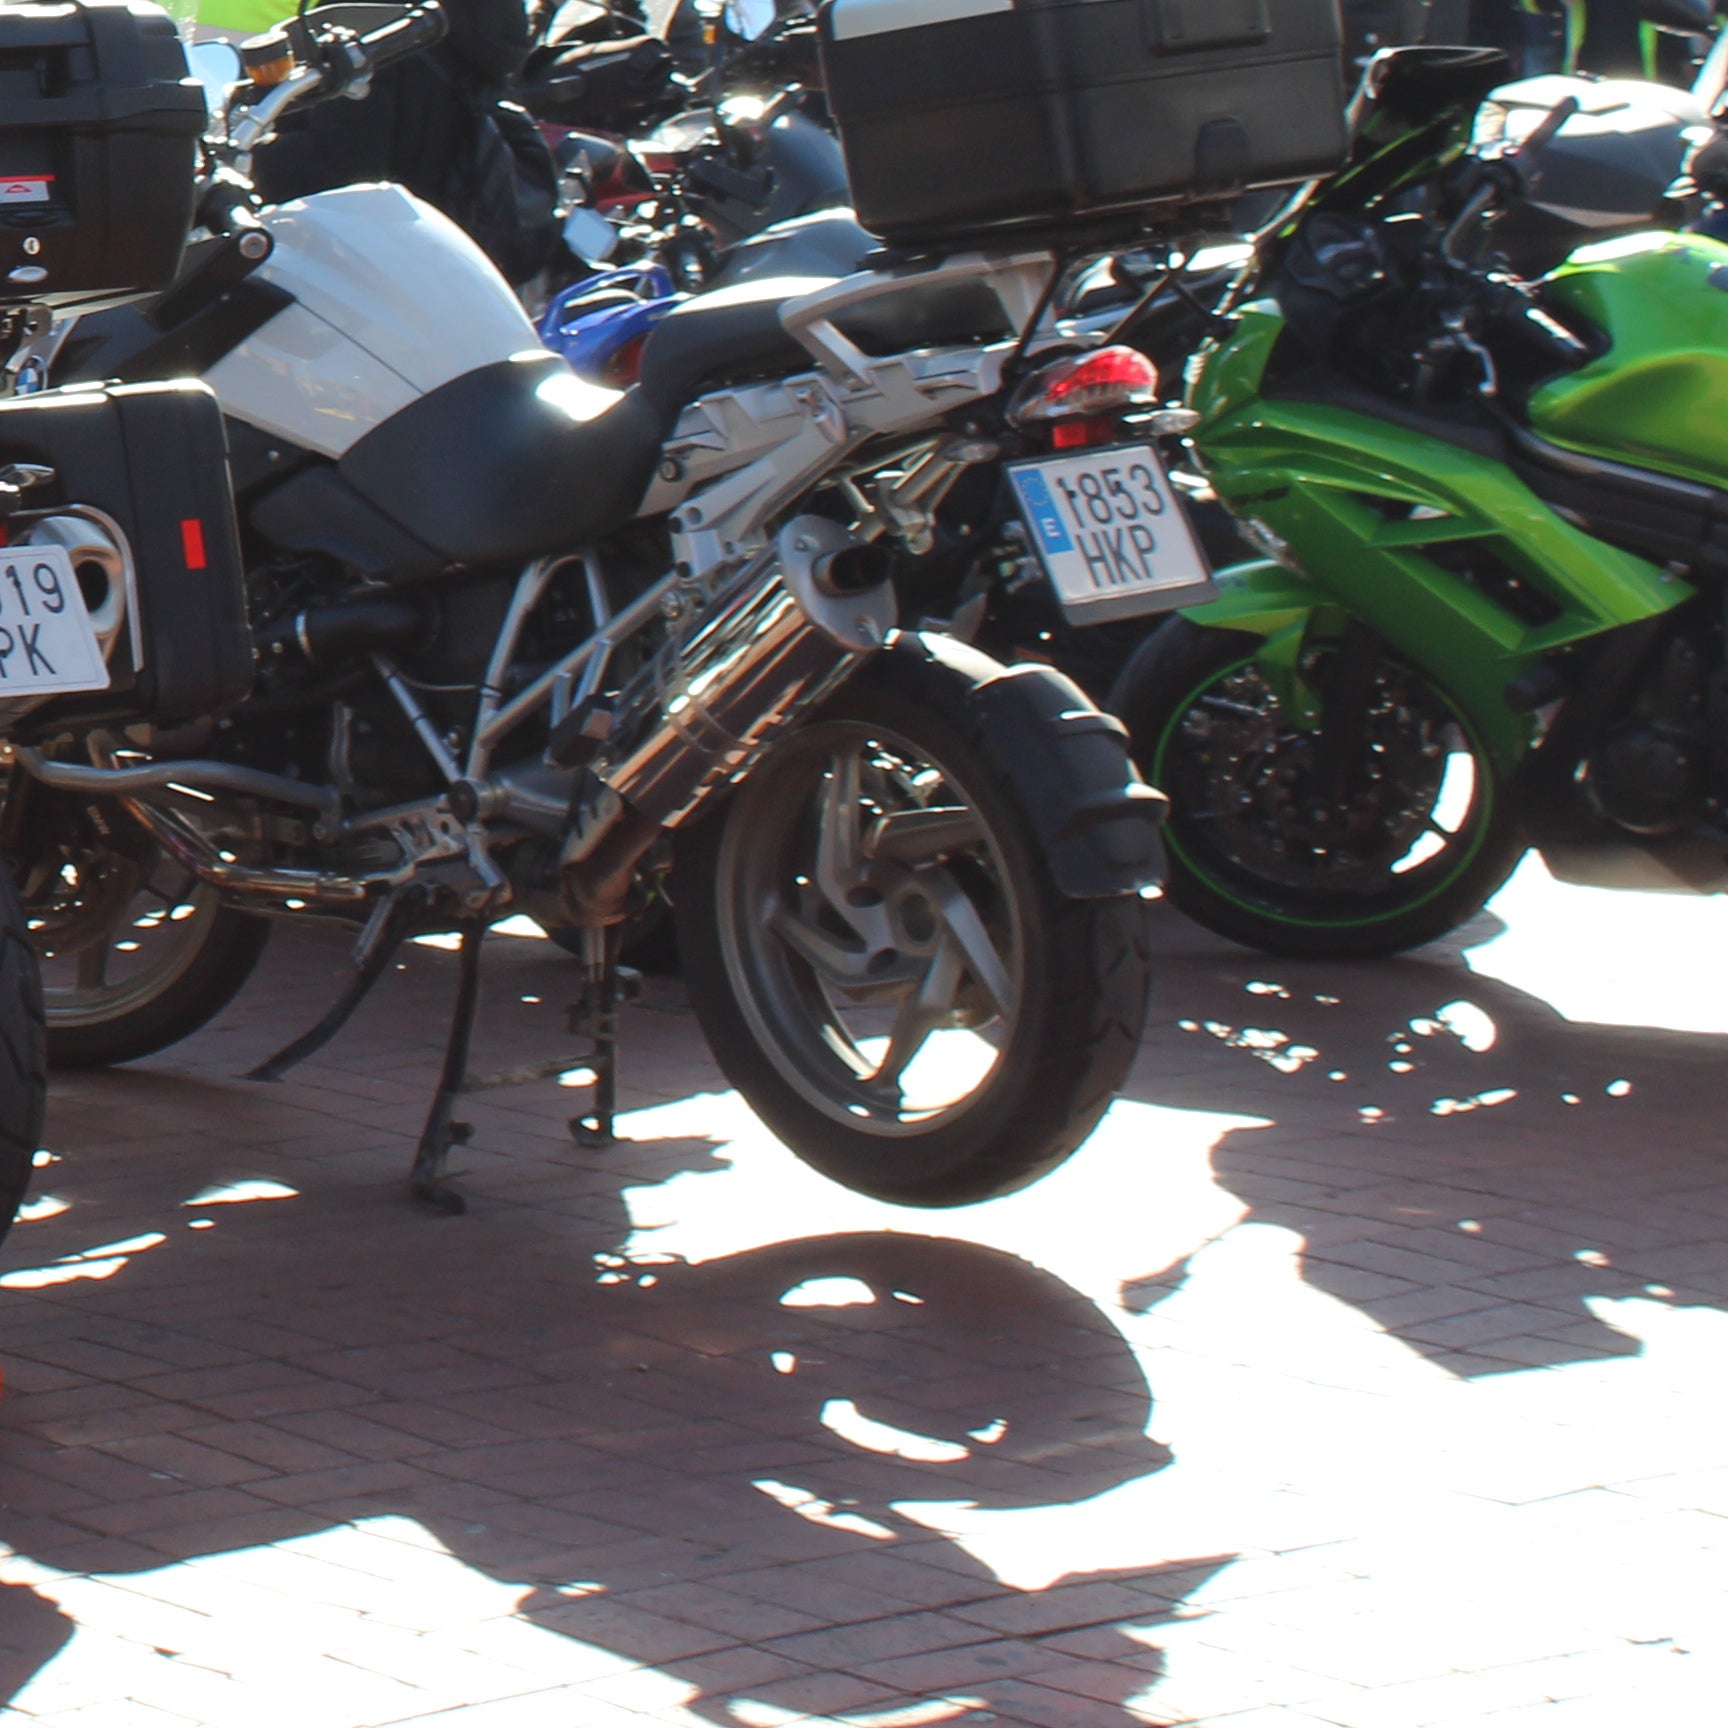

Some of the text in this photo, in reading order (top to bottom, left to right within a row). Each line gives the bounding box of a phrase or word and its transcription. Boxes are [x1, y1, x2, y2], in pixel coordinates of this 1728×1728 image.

[1041, 516, 1062, 539] E
[1055, 463, 1164, 529] 1853
[1075, 524, 1155, 589] HKP
